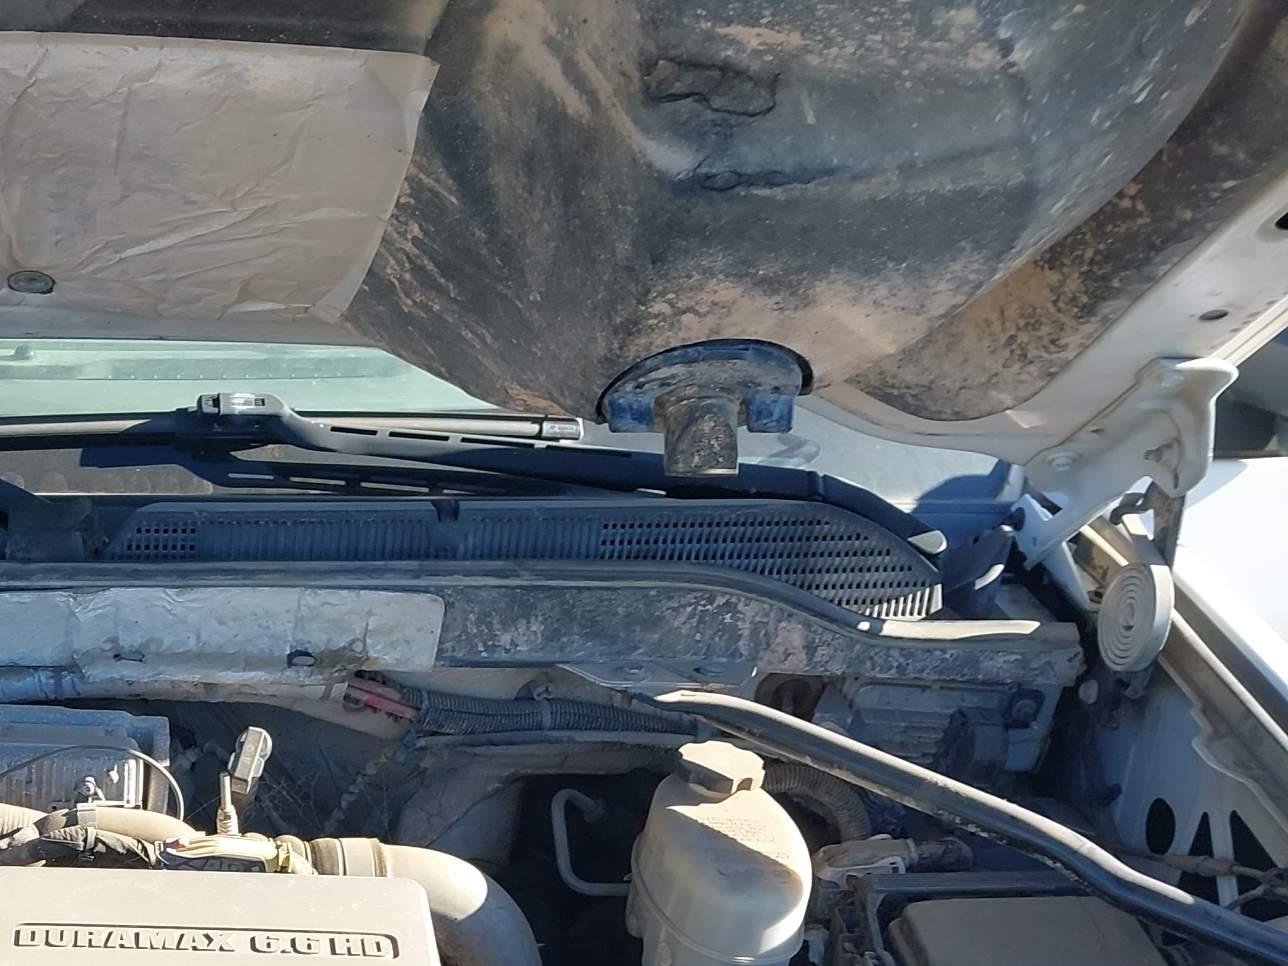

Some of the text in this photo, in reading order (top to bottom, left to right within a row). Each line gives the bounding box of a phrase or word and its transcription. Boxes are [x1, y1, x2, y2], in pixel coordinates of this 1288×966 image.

[13, 928, 391, 958] DURAMAX 6.6 HD
